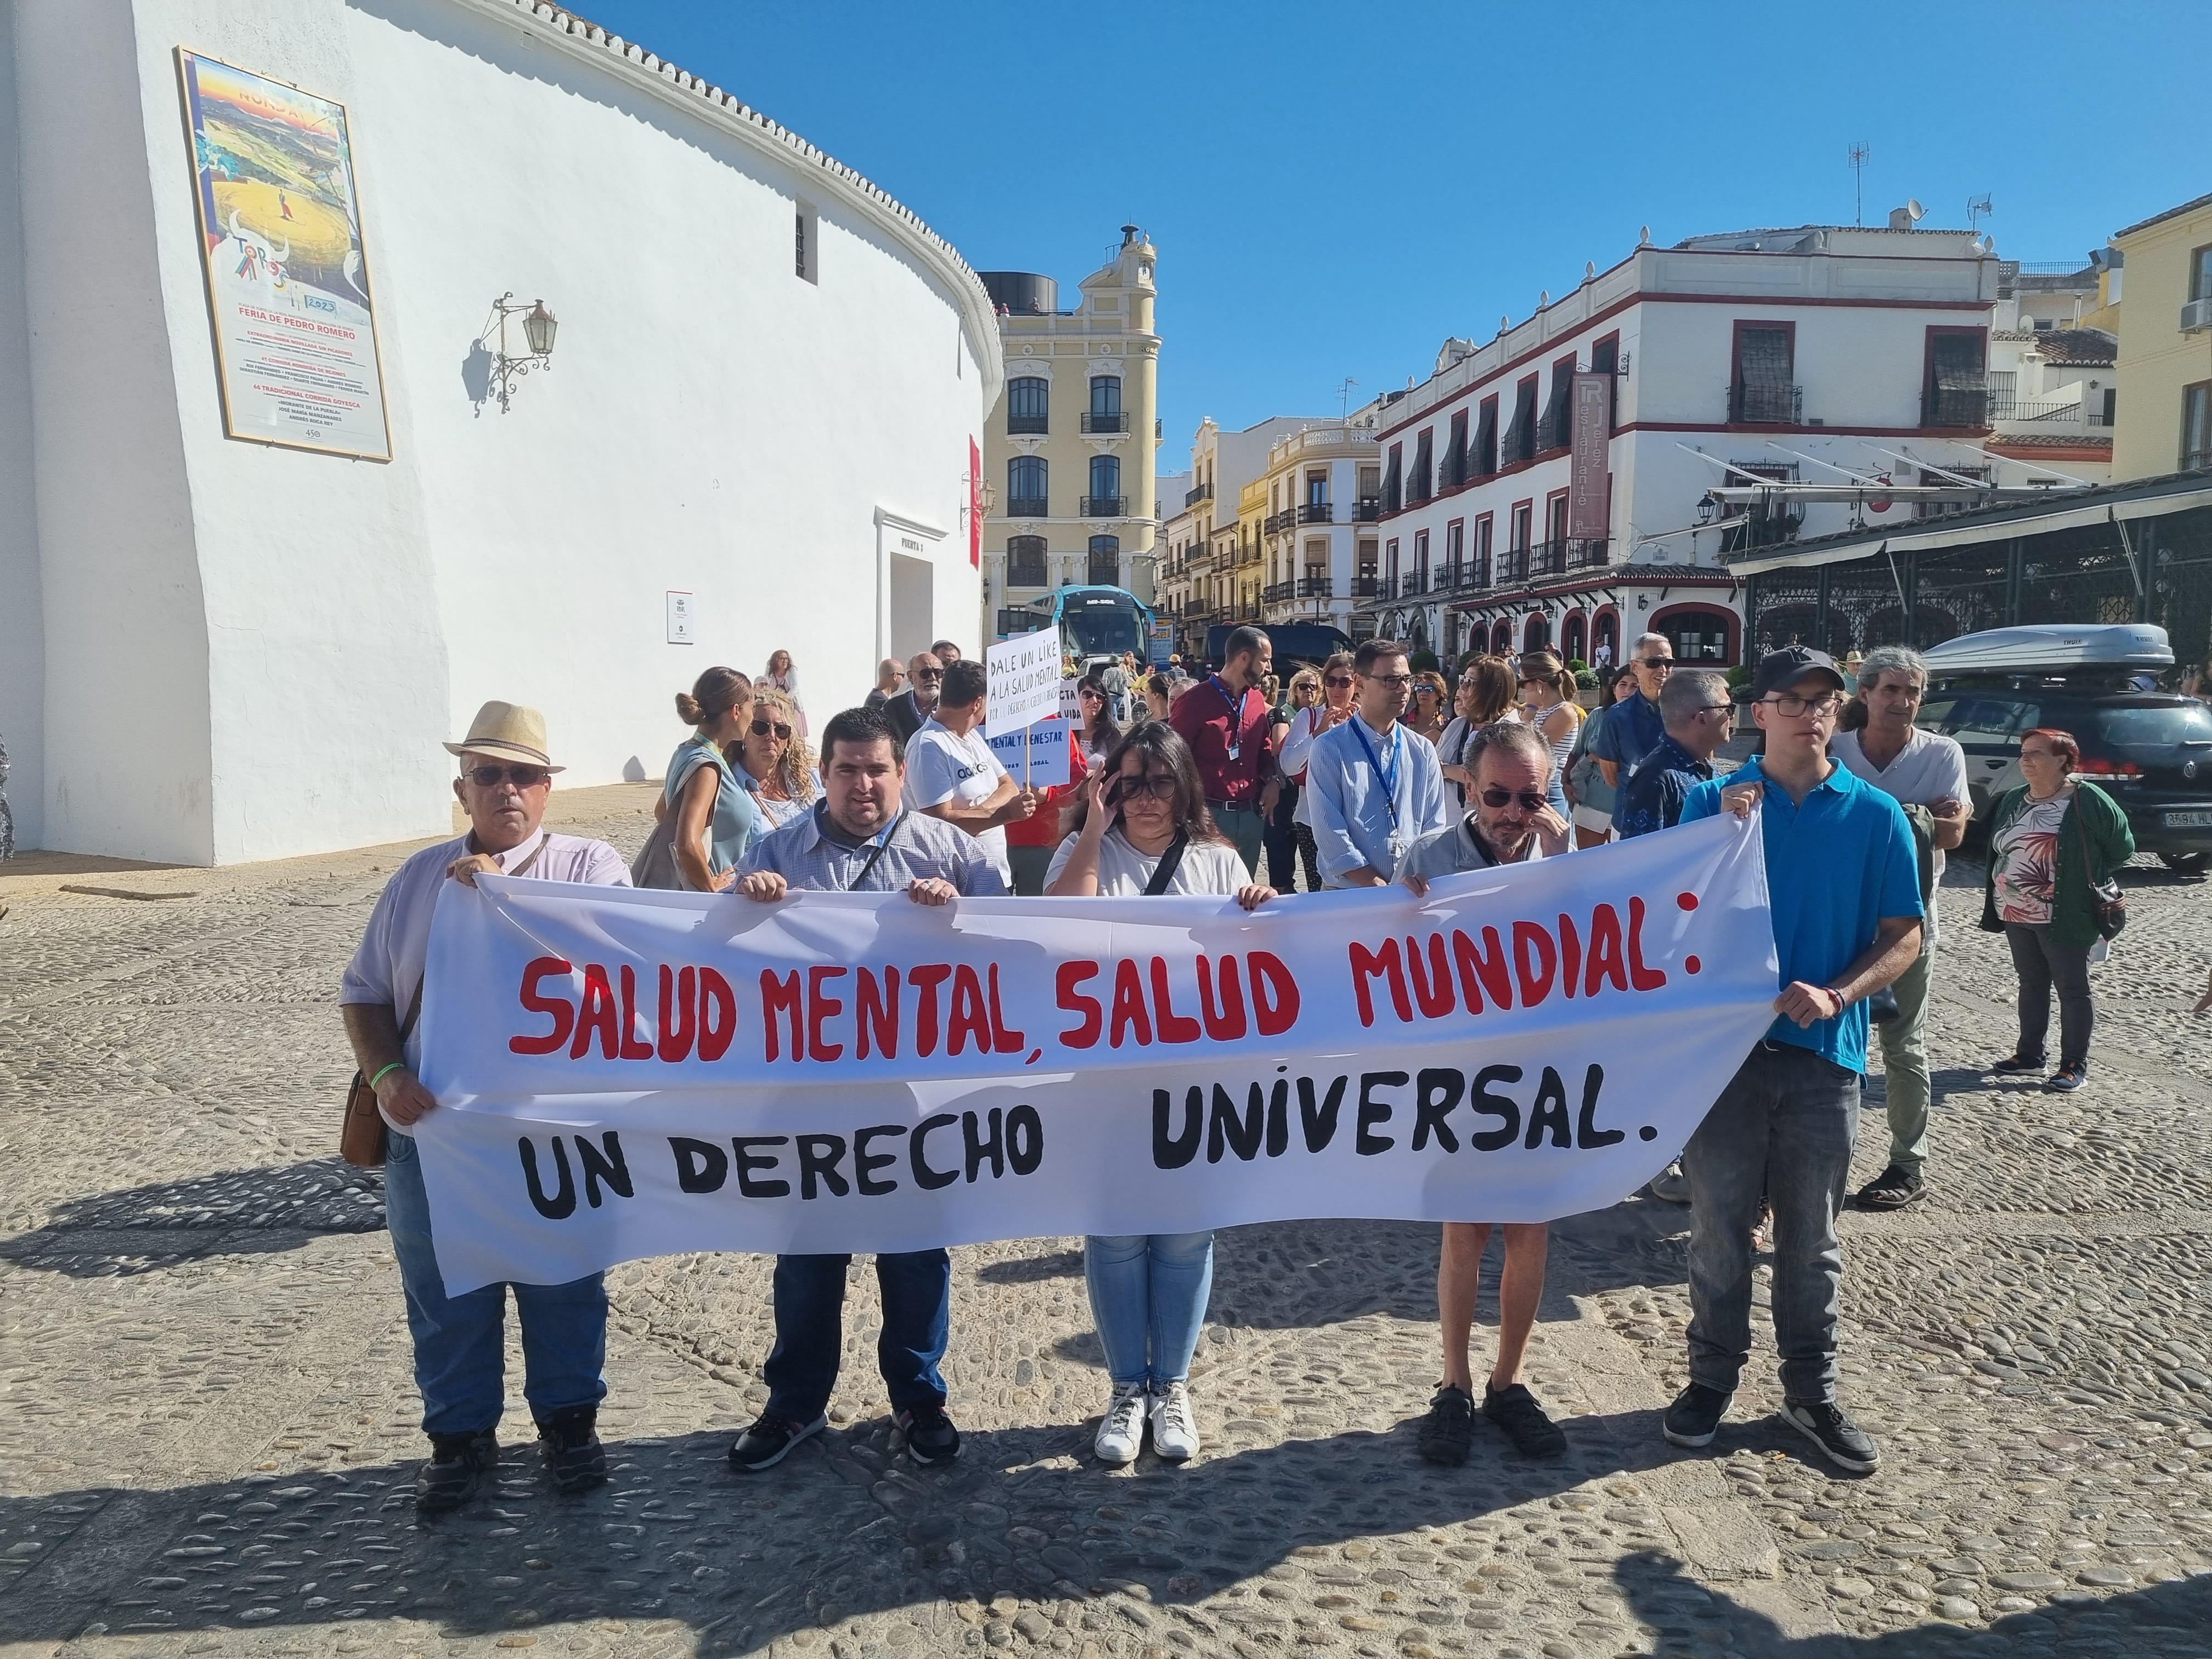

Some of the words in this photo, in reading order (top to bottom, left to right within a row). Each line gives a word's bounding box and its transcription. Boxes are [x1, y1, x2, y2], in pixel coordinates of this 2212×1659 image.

[232, 235, 290, 289] TOROS
[309, 298, 335, 313] 2023
[239, 307, 267, 319] FERIA
[269, 314, 281, 323] DE
[284, 318, 314, 330] PEDRO
[317, 325, 354, 340] ROMERO
[262, 386, 303, 398] TRADICIONAL
[305, 394, 331, 403] CORRIDA
[332, 399, 360, 408] GOYESCA
[1592, 406, 1602, 467] Jerez
[902, 538, 919, 551] PUERTA
[991, 655, 1017, 677] DALE
[1021, 650, 1034, 669] UN
[990, 685, 996, 702] A
[1000, 680, 1009, 699] LA
[1012, 675, 1034, 695] SALUD
[1035, 664, 1058, 687] MENTAL
[1059, 690, 1076, 701] CTA
[990, 708, 998, 721] POR
[1008, 699, 1026, 715] DERECHO
[1064, 709, 1082, 719] VIDA
[991, 735, 1015, 749] MENTAL
[1017, 734, 1023, 746] Y
[1025, 731, 1063, 746] ENESTAR
[2198, 812, 2212, 825] HL
[509, 956, 736, 1063] SALUD
[759, 962, 1041, 1065] MENTAL,
[1056, 951, 1301, 1049] SALUD
[1348, 891, 1701, 1029] MUNDIAL:
[518, 1130, 635, 1220] UN
[667, 1104, 1044, 1200] DERECHO
